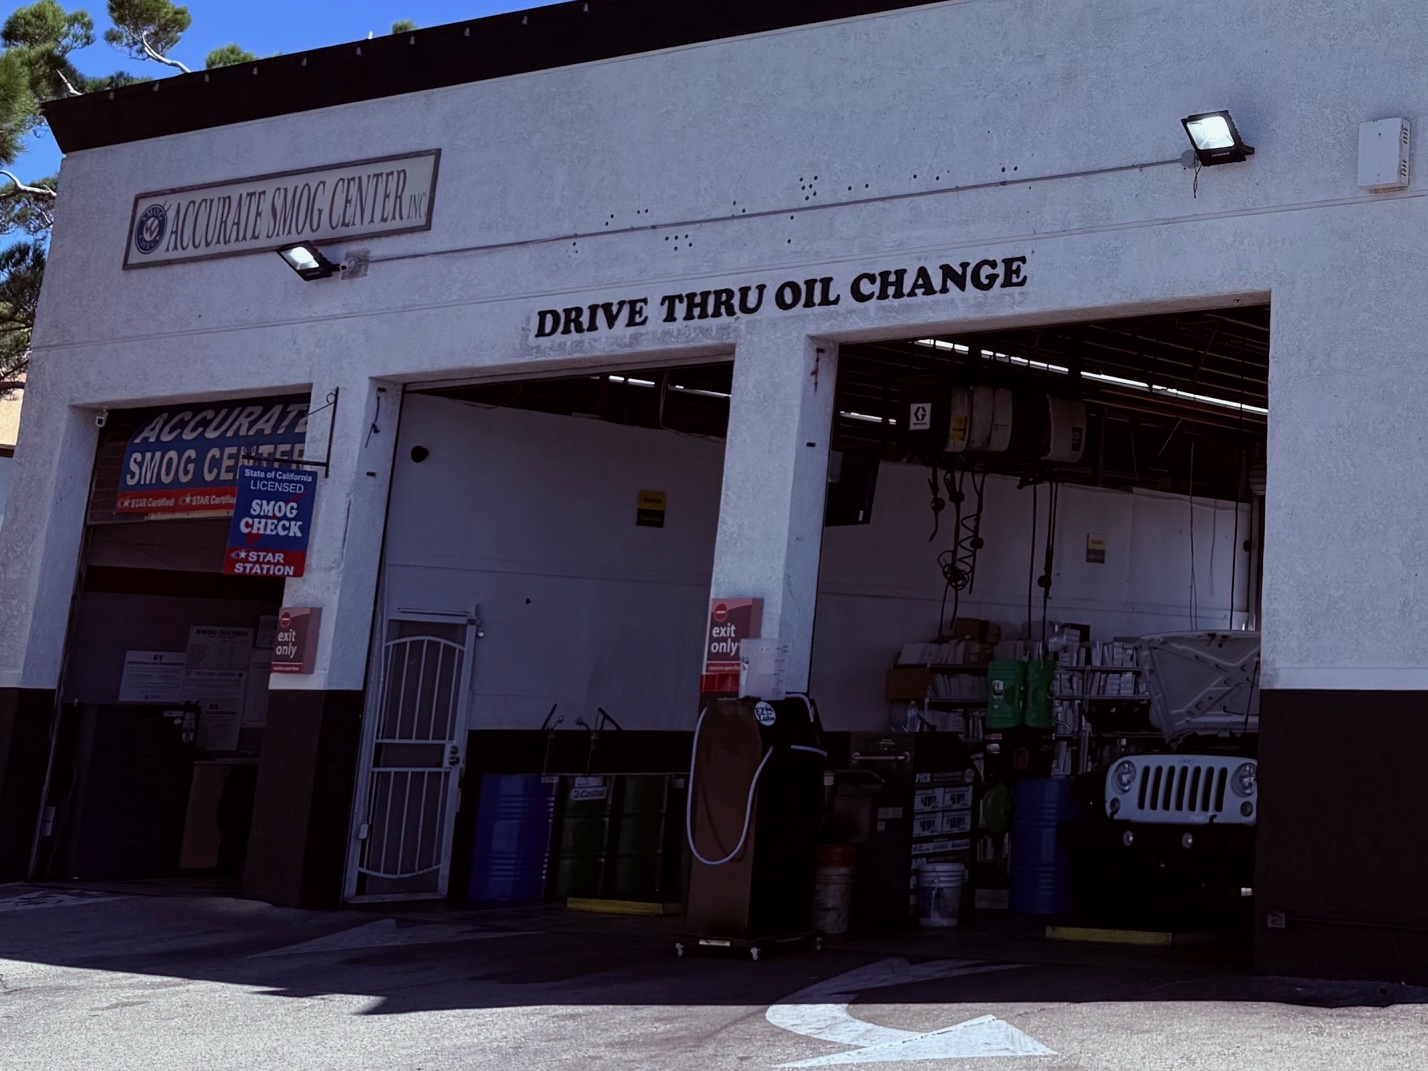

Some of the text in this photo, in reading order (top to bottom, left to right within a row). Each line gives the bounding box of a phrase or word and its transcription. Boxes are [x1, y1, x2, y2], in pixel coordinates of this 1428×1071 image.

[165, 189, 265, 253] ACCURATE
[266, 180, 326, 239] SMOG
[328, 168, 407, 231] CENTER
[535, 255, 1027, 338] DRIVE THRU OIL CHANGE
[126, 448, 197, 486] SMOG
[244, 468, 313, 483] State of California
[250, 480, 304, 494] LICENSED
[192, 494, 236, 505] STAR Certifie
[250, 499, 298, 517] SMOG
[239, 517, 303, 537] CHECK
[248, 551, 285, 563] STAR
[234, 562, 294, 576] STATION
[277, 628, 297, 643] exit
[712, 622, 736, 637] exit
[275, 642, 297, 659] only
[710, 638, 740, 657] only
